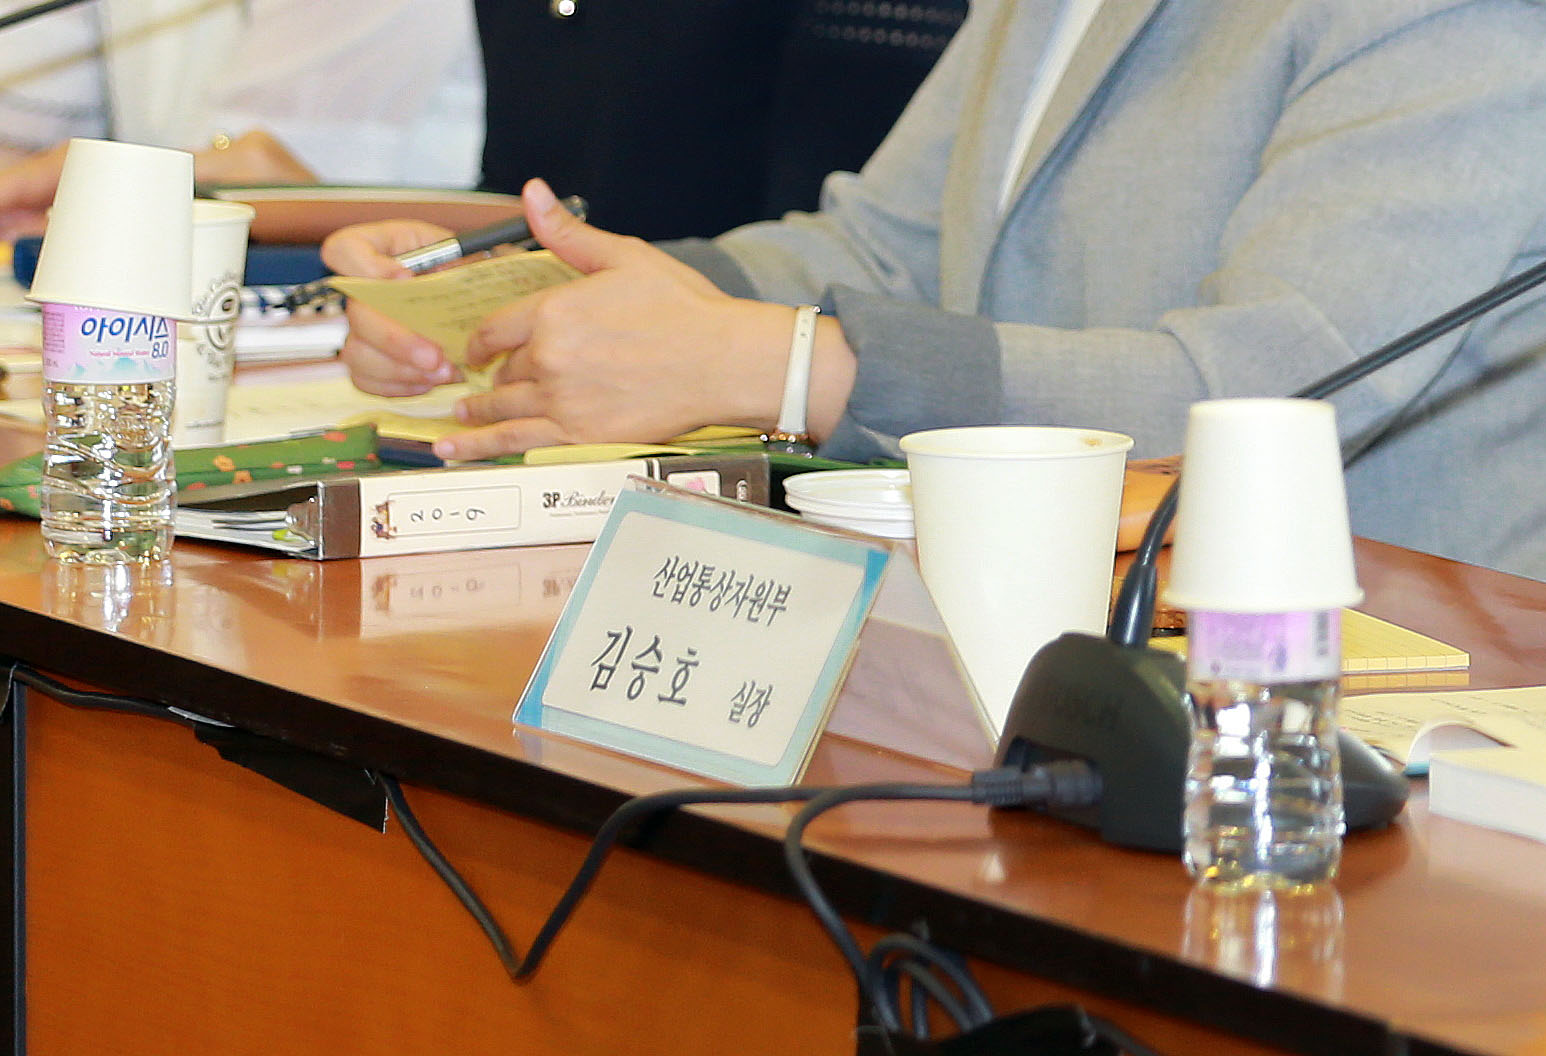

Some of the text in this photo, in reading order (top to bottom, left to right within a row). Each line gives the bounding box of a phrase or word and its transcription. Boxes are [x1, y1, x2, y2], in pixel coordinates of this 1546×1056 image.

[81, 315, 169, 343] 아이시스
[151, 340, 169, 359] 8.0
[542, 491, 561, 509] 3P
[652, 555, 792, 627] 산업통상자원부
[589, 625, 773, 729] 김승호 실장
